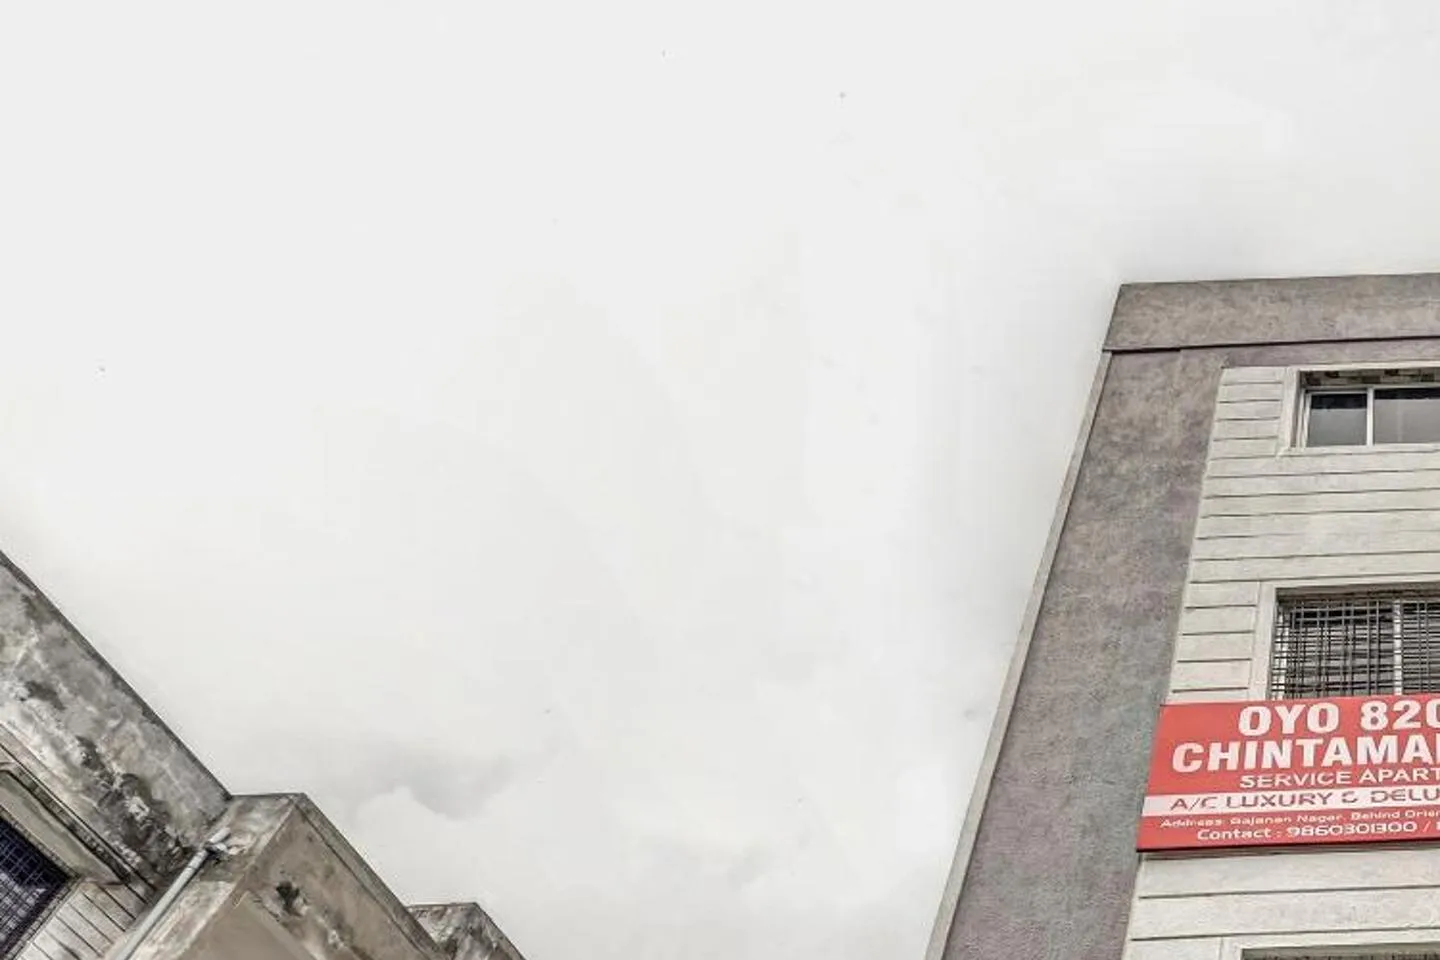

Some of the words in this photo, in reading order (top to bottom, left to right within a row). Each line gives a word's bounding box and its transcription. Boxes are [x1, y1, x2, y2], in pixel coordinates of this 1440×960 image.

[1238, 703, 1341, 737] OYO
[1239, 771, 1352, 789] SERVICE
[1170, 796, 1218, 811] A/C
[1226, 791, 1333, 808] LUXURY
[1350, 809, 1401, 821] Behind
[1197, 827, 1272, 841] Contact
